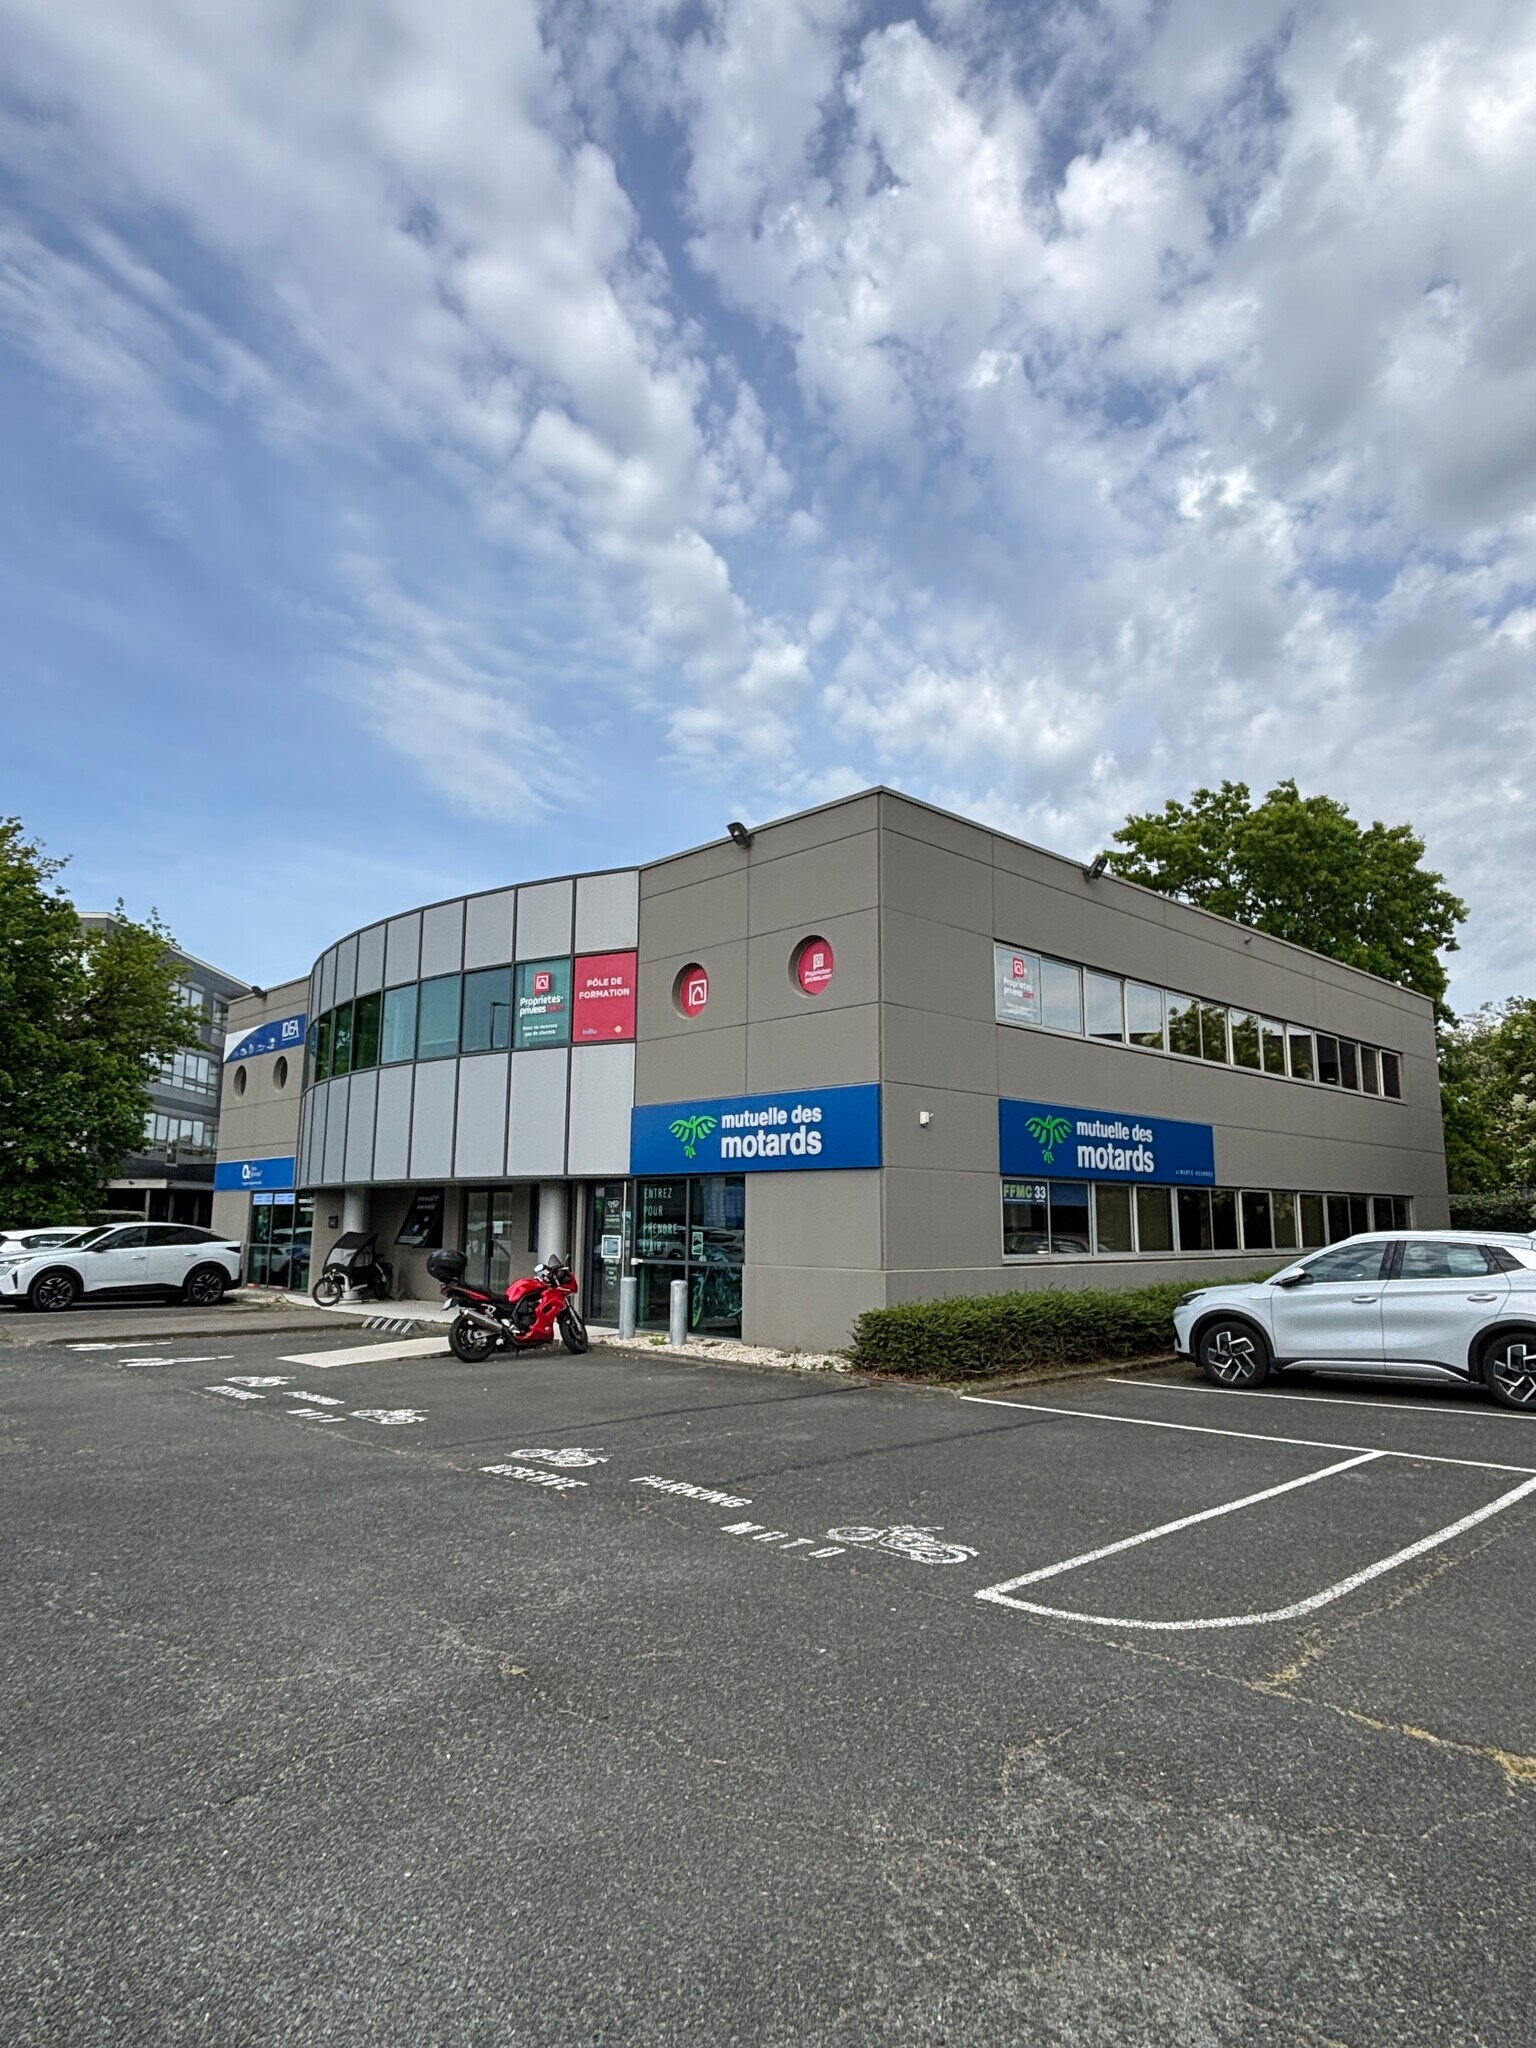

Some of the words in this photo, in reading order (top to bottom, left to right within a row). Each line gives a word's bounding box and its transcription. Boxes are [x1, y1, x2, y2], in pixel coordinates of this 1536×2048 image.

[587, 977, 609, 988] PÔLE
[611, 977, 622, 986] DE
[579, 988, 630, 1000] FORMATION
[721, 1107, 787, 1129] mutuelle
[791, 1105, 822, 1124] des
[1076, 1121, 1130, 1141] mutuelle
[1132, 1124, 1153, 1143] des
[721, 1125, 822, 1159] motards
[1077, 1143, 1155, 1173] motards
[644, 1187, 673, 1199] ENTREZ
[1003, 1184, 1033, 1199] FFMC
[1034, 1185, 1046, 1199] 33
[643, 1205, 663, 1216] POUR
[643, 1223, 677, 1235] PRENDRE
